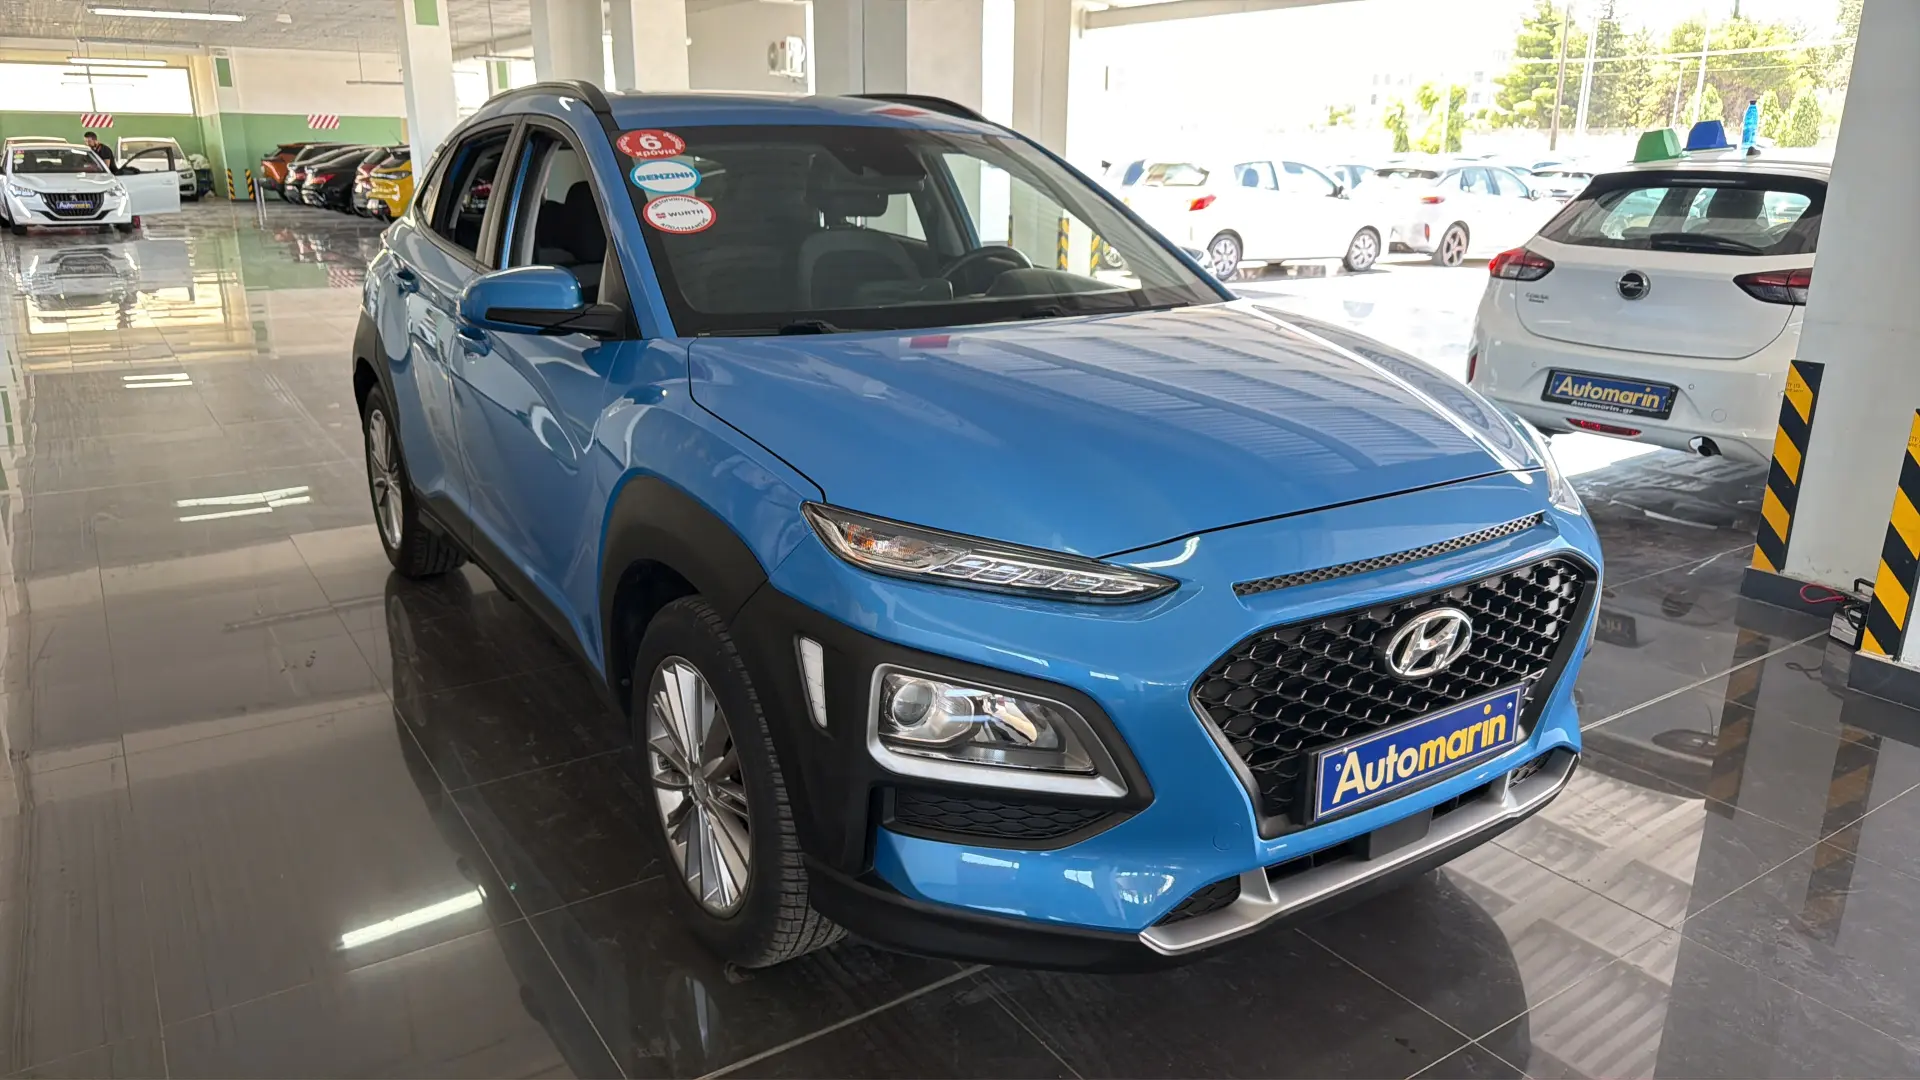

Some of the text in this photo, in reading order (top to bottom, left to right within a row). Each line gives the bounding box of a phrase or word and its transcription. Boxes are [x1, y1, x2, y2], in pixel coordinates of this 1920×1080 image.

[639, 134, 662, 150] 6
[635, 149, 677, 157] χρόνια
[1555, 376, 1660, 409] Automarin
[1571, 400, 1634, 414] Automarin.gr
[1332, 704, 1506, 805] Automarin
